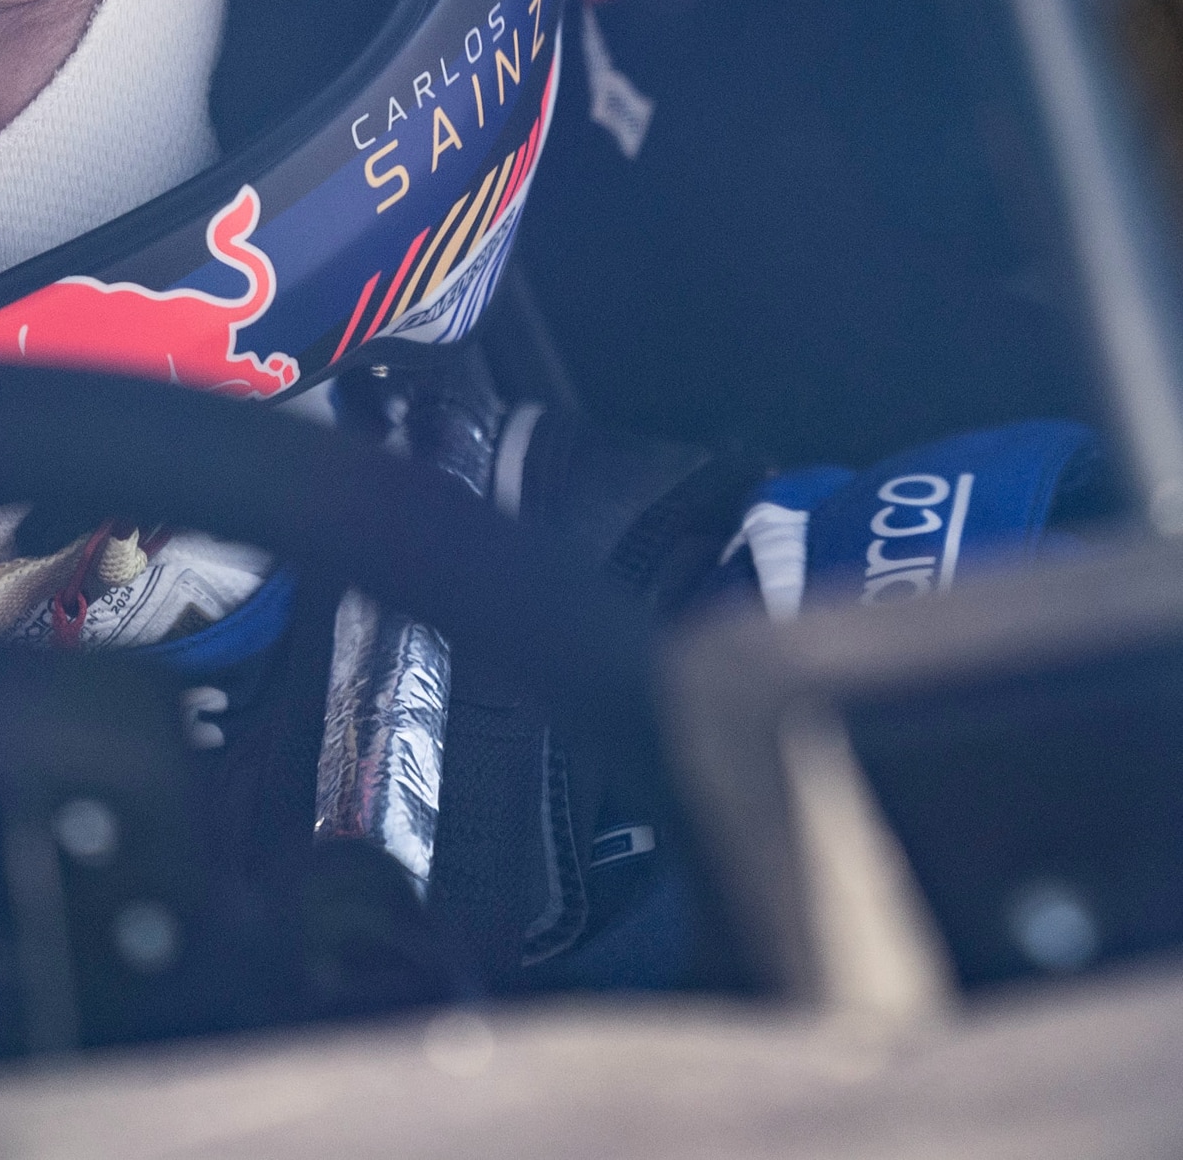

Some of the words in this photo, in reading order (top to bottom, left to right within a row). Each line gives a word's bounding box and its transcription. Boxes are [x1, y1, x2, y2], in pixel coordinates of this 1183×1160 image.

[350, 1, 506, 150] CARLOS
[110, 585, 135, 615] 2034
[860, 473, 951, 607] arco
